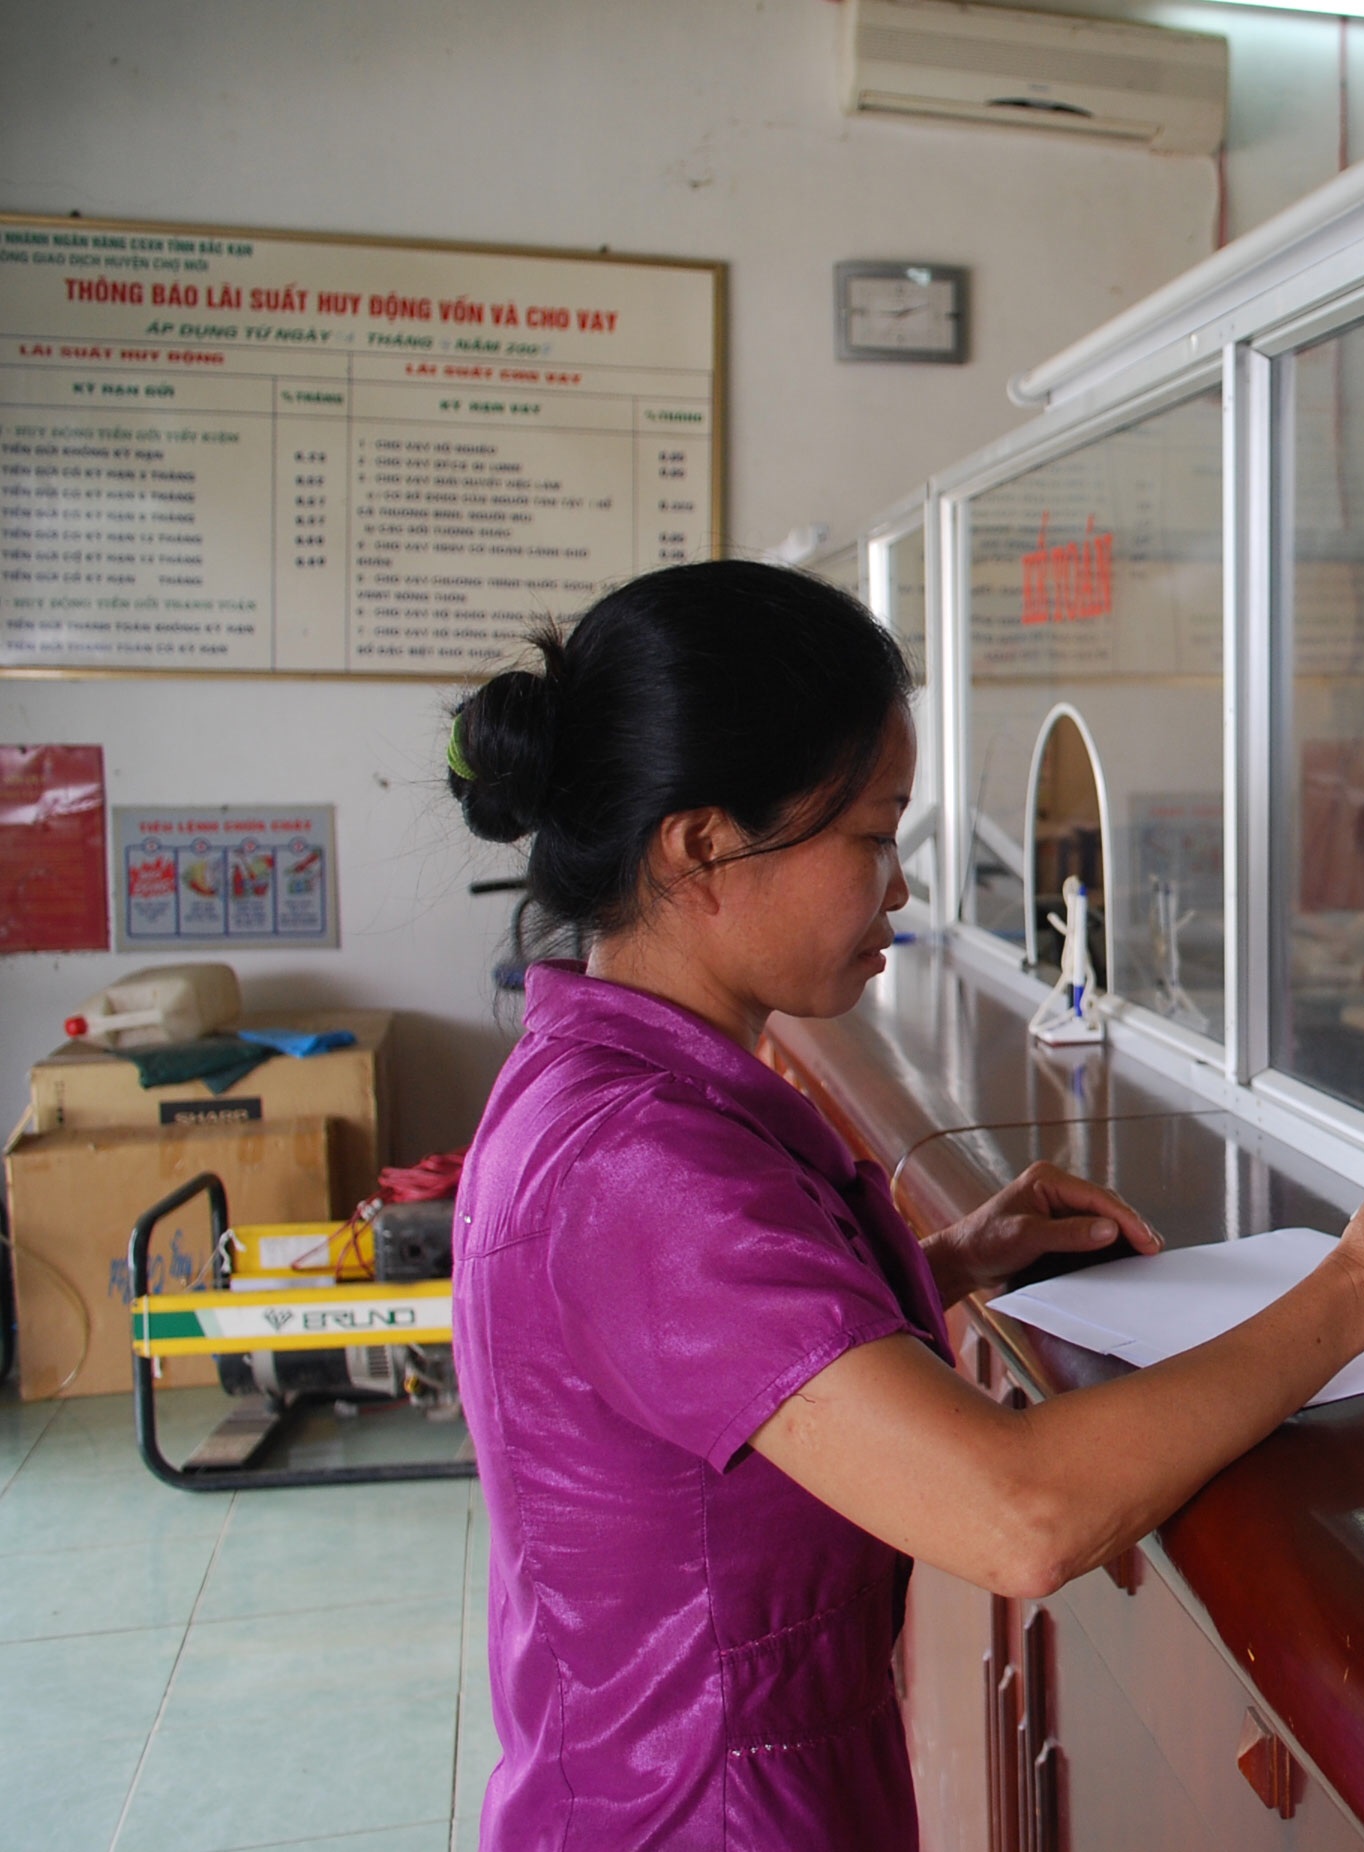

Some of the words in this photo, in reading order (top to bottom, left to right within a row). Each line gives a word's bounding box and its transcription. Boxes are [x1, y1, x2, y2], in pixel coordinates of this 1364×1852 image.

[65, 275, 143, 305] THÔNG
[152, 280, 198, 308] BÁO
[207, 282, 242, 311] LÃI
[250, 283, 308, 313] SUẤT
[318, 293, 361, 315] HUY
[370, 292, 431, 325] ĐỘNG
[439, 294, 483, 325] VỐN
[491, 302, 519, 327] VÀ
[527, 309, 569, 332] CHO
[577, 310, 618, 333] VAY
